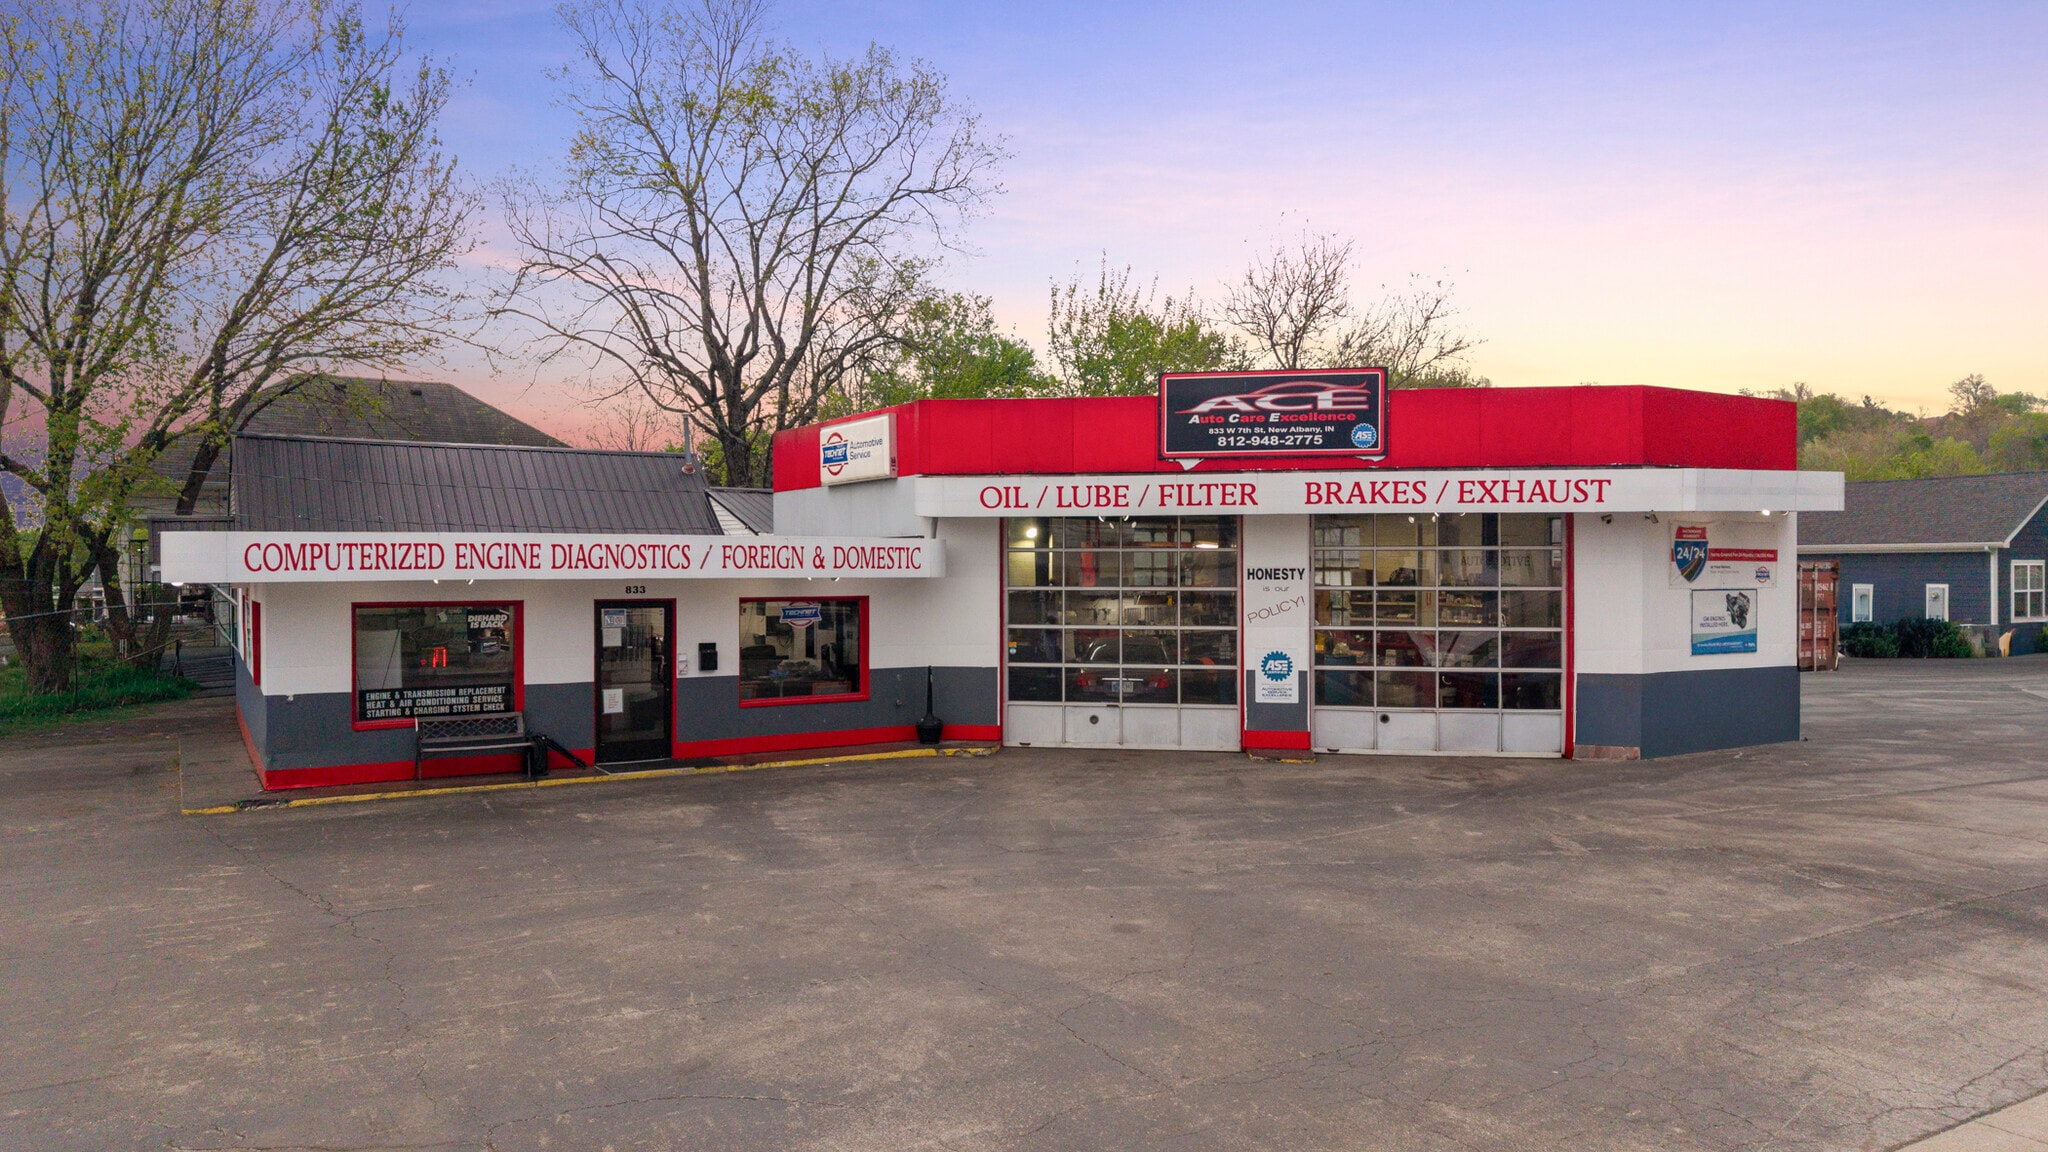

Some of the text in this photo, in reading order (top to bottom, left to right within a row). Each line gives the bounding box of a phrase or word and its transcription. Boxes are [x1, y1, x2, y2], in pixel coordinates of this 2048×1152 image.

[1176, 388, 1371, 414] ACE
[1188, 411, 1357, 424] Auto Care Excellence
[1208, 427, 1224, 435] 833
[1253, 427, 1267, 435] St,
[1289, 426, 1323, 435] Albany,
[1324, 425, 1335, 433] IN
[1355, 431, 1372, 440] ASE
[850, 438, 883, 450] Automotive
[1217, 434, 1324, 447] 812-948-2775
[850, 451, 871, 460] Service
[980, 483, 1259, 509] OIL / LUBE / FILTER
[1304, 479, 1612, 505] BRAKES / EXHAUST
[244, 542, 922, 572] COMPUTERIZED ENGINE DIAGNOSTICS / FOREIGN & DOMESTIC
[1677, 546, 1705, 560] 24/24
[1247, 568, 1305, 581] HONESTY
[625, 585, 646, 594] 833
[1247, 596, 1306, 624] POLICY!
[467, 614, 508, 623] DIEHARD
[480, 620, 504, 628] BACK
[1265, 660, 1288, 671] ASE
[366, 691, 391, 700] ENGINE
[403, 689, 456, 698] TRANSMISSION
[458, 686, 506, 695] REPLACEMENT
[366, 695, 503, 709] HEAT & AIR CONDITIONING SERVICE
[366, 703, 505, 718] STARTING & CHARGING SYSTEM CHECK
